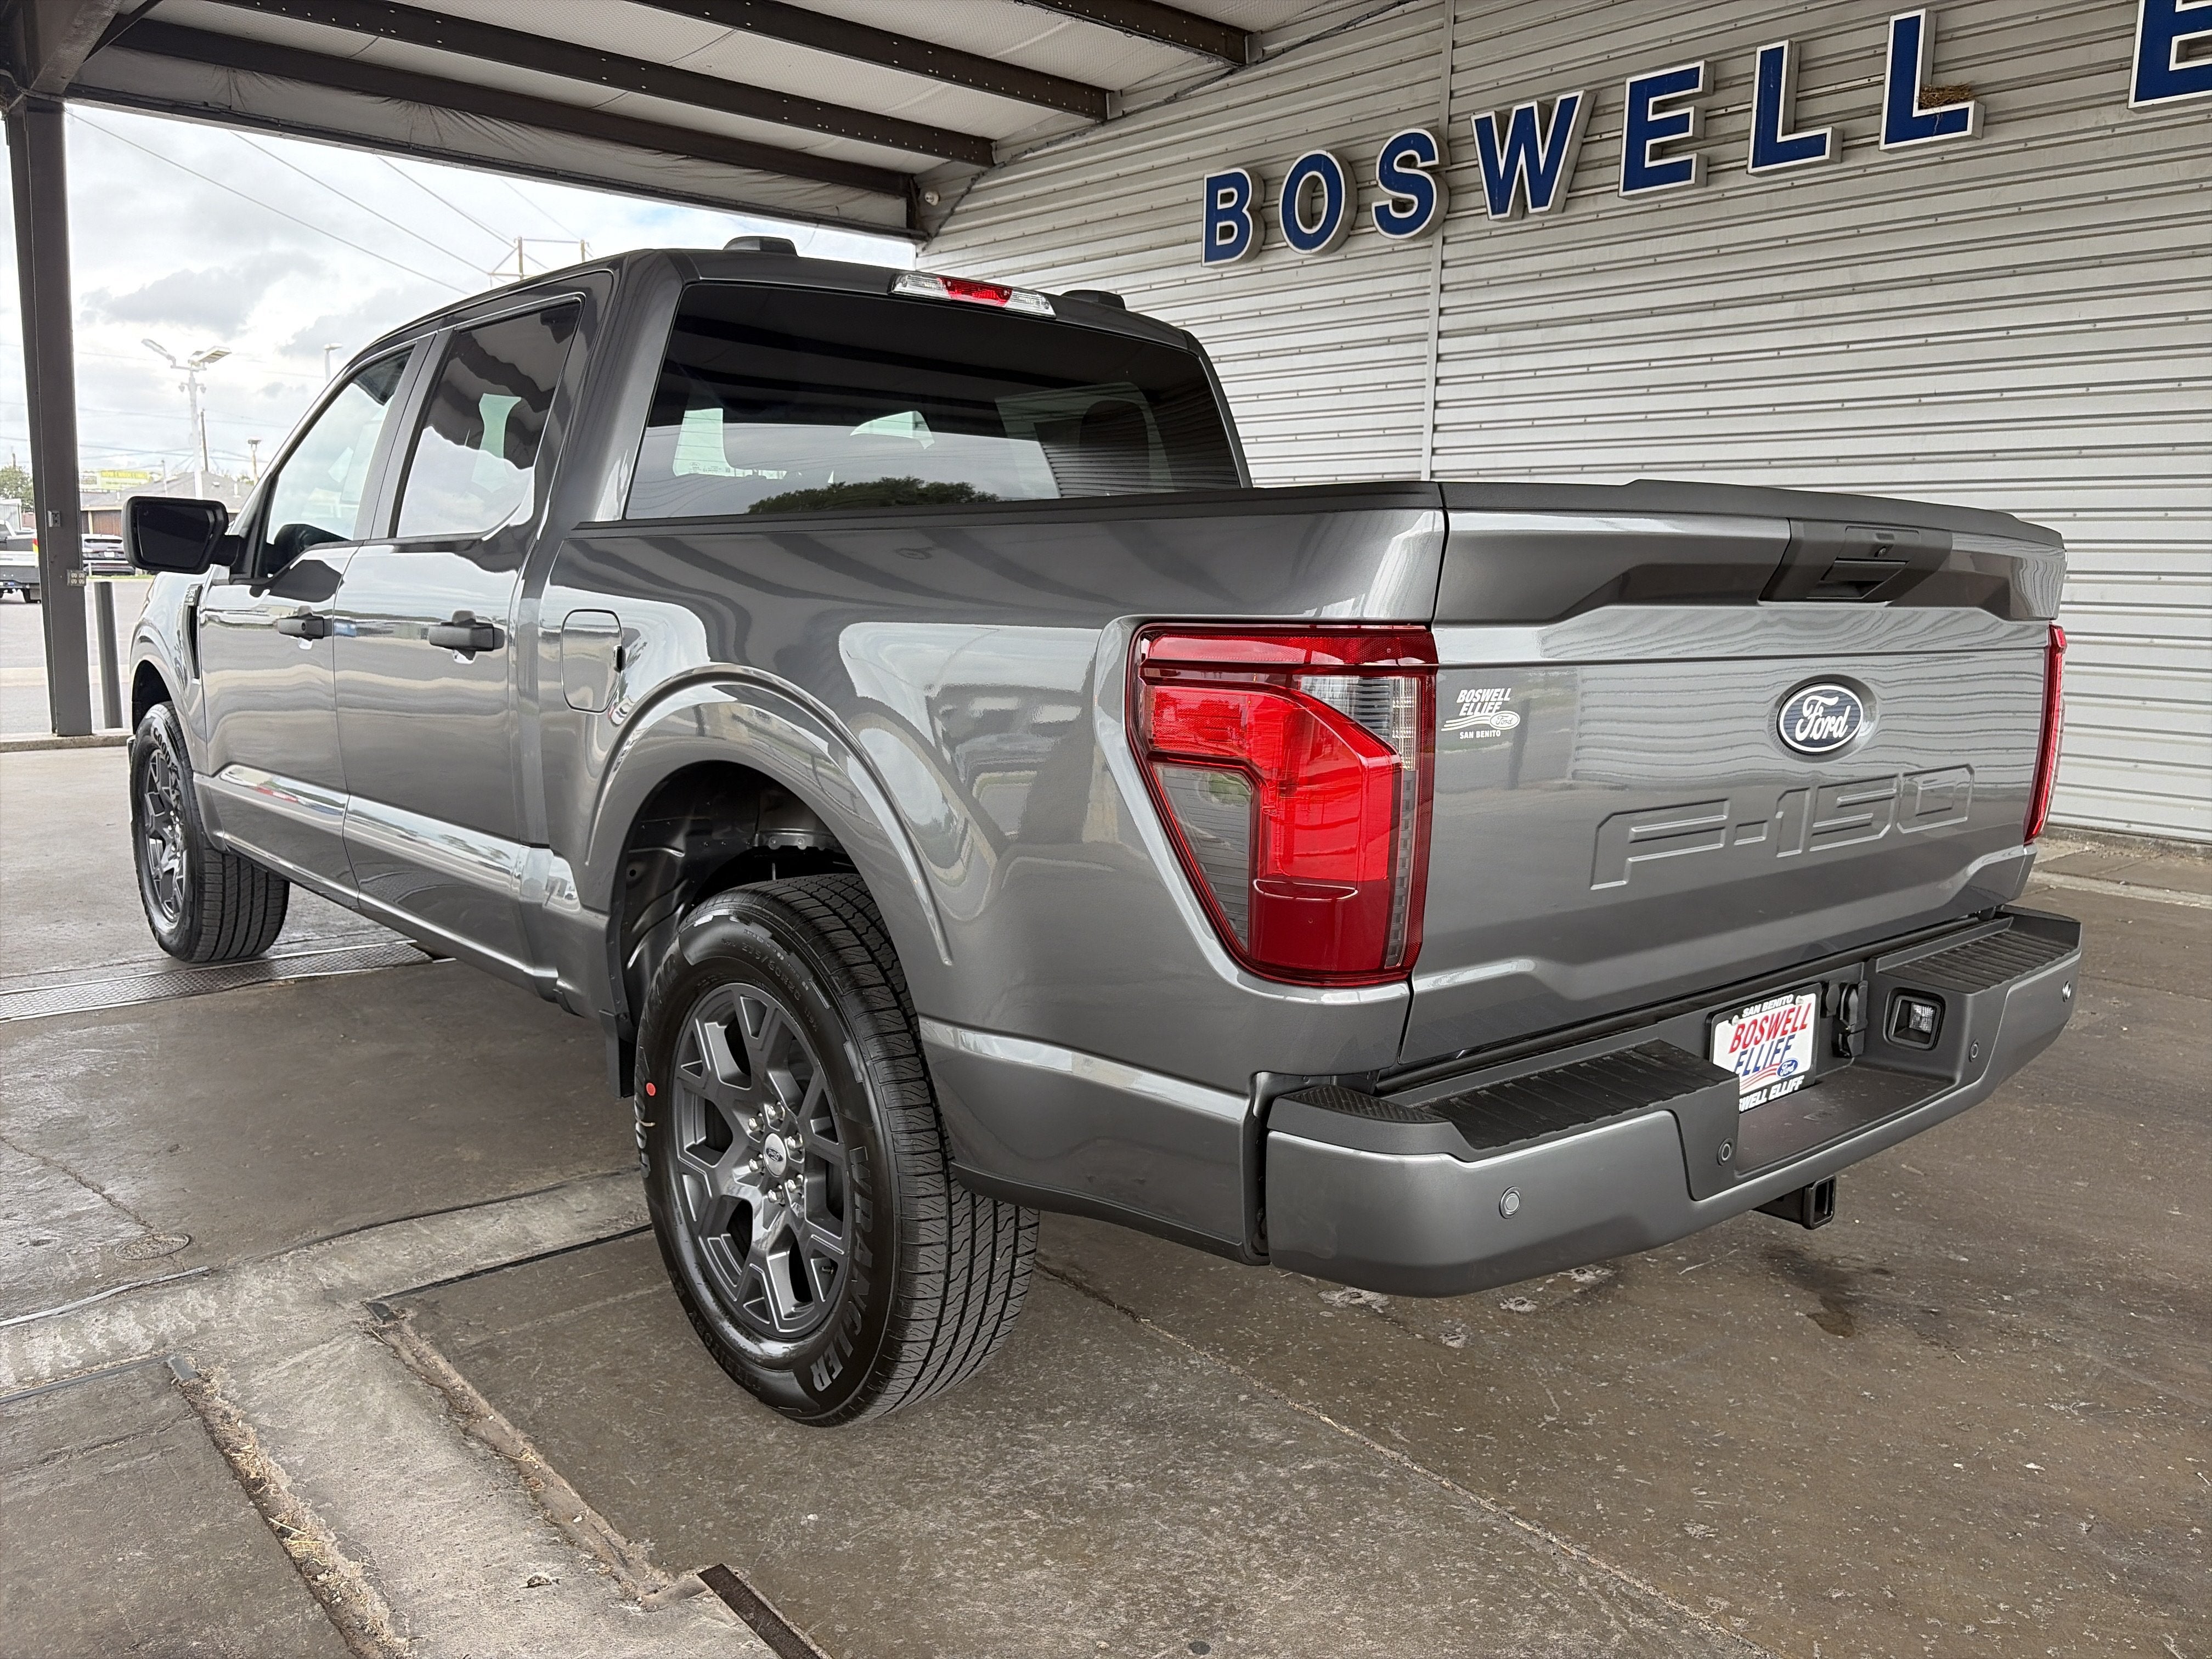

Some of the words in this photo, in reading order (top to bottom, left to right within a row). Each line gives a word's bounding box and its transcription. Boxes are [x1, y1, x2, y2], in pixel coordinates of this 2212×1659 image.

[1201, 10, 1982, 267] BOSWELL
[1456, 687, 1512, 703] BOSWELL
[1459, 701, 1503, 716] ELLIFF
[1496, 715, 1513, 725] Ford
[1795, 695, 1852, 741] Ford
[1459, 731, 1474, 740] SAN
[1476, 730, 1501, 738] BENITO
[1589, 764, 1975, 890] F-150
[1742, 1003, 1760, 1018] SAN
[1761, 994, 1793, 1012] BENITO
[1728, 1002, 1813, 1054] BOSWELL
[1734, 1034, 1796, 1077] ELLIFF
[1779, 1060, 1797, 1075] Ford
[1768, 1075, 1805, 1101] ELLIFF
[810, 1146, 873, 1392] WRANGLER
